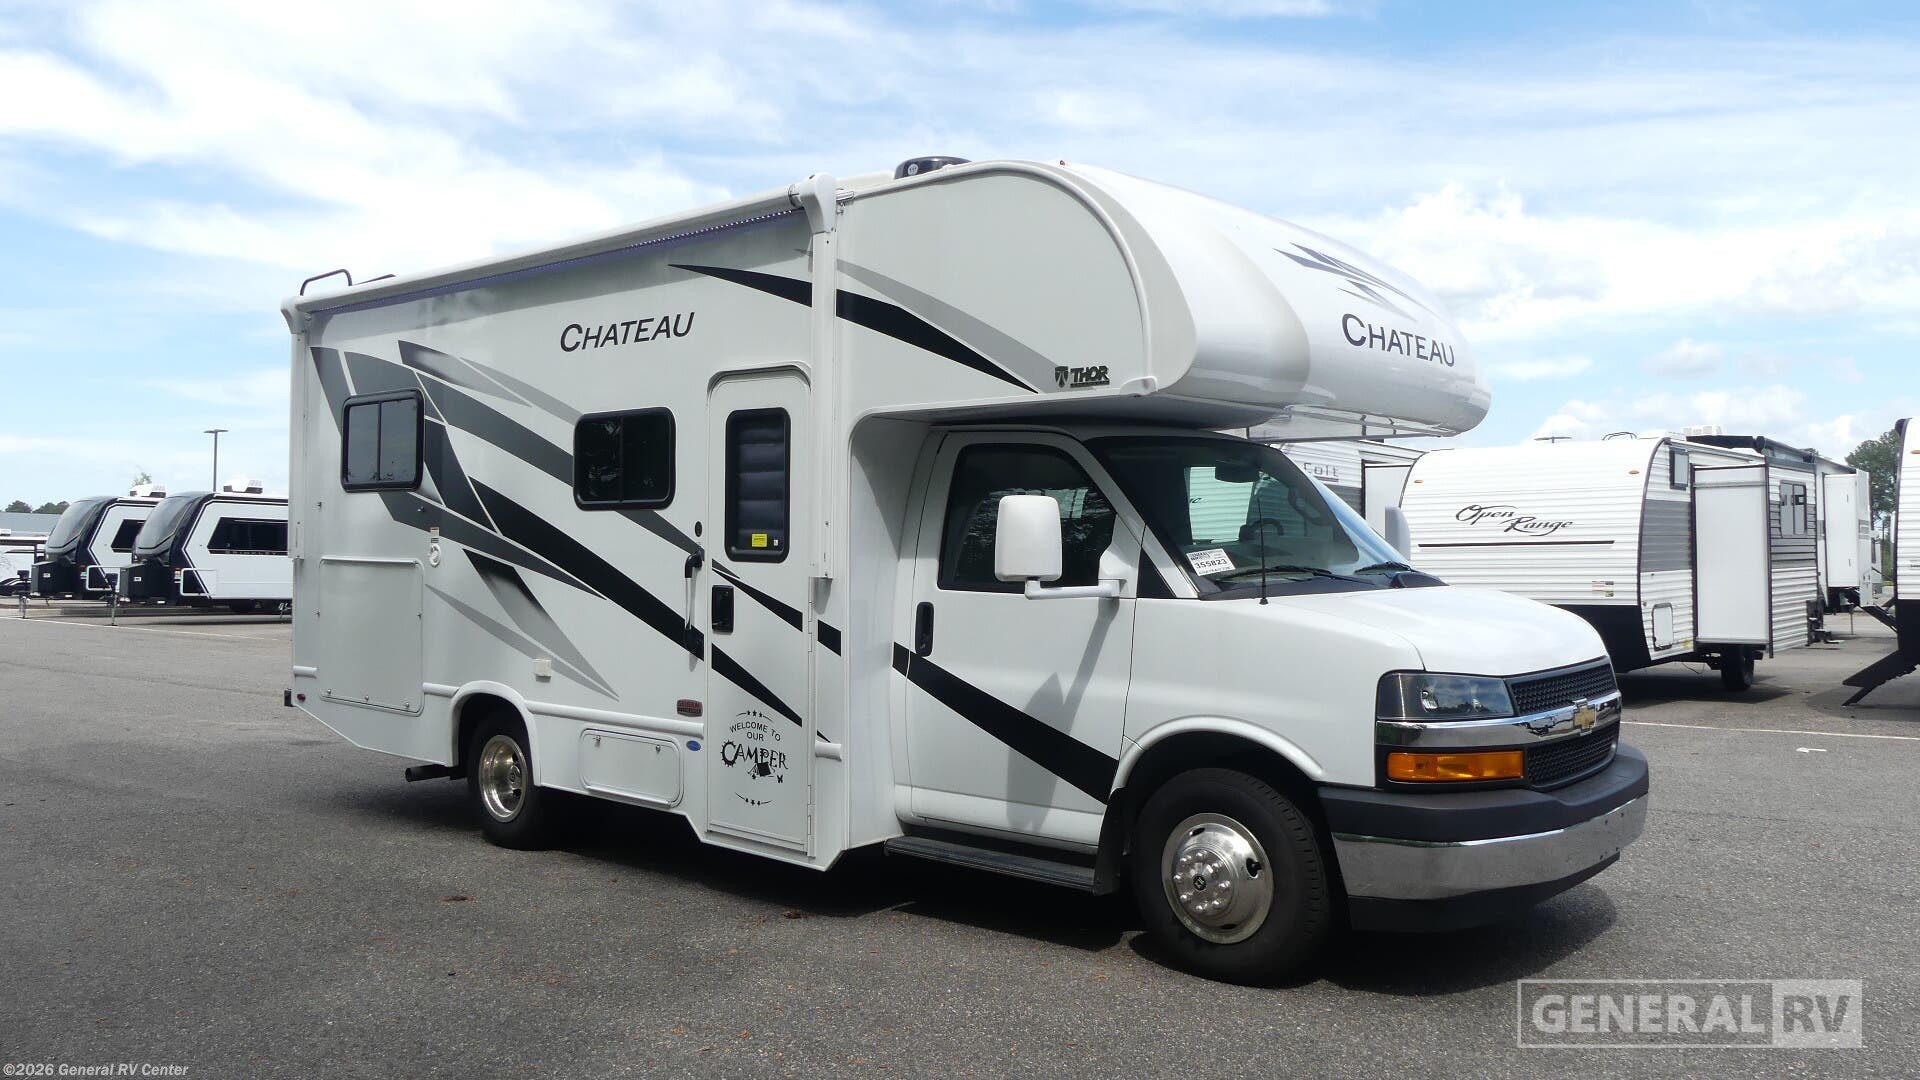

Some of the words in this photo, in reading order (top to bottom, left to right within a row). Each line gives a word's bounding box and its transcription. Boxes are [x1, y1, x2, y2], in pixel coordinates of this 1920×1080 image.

[560, 311, 695, 352] CHATEAU
[1341, 313, 1455, 367] CHATEAU
[1070, 365, 1110, 382] THOR
[1455, 504, 1519, 525] Open
[1498, 516, 1574, 536] Range
[1194, 558, 1228, 569] 355823
[729, 721, 768, 734] WELCOME
[771, 728, 781, 742] TO
[746, 731, 764, 742] OUR
[720, 740, 789, 768] CAMPER
